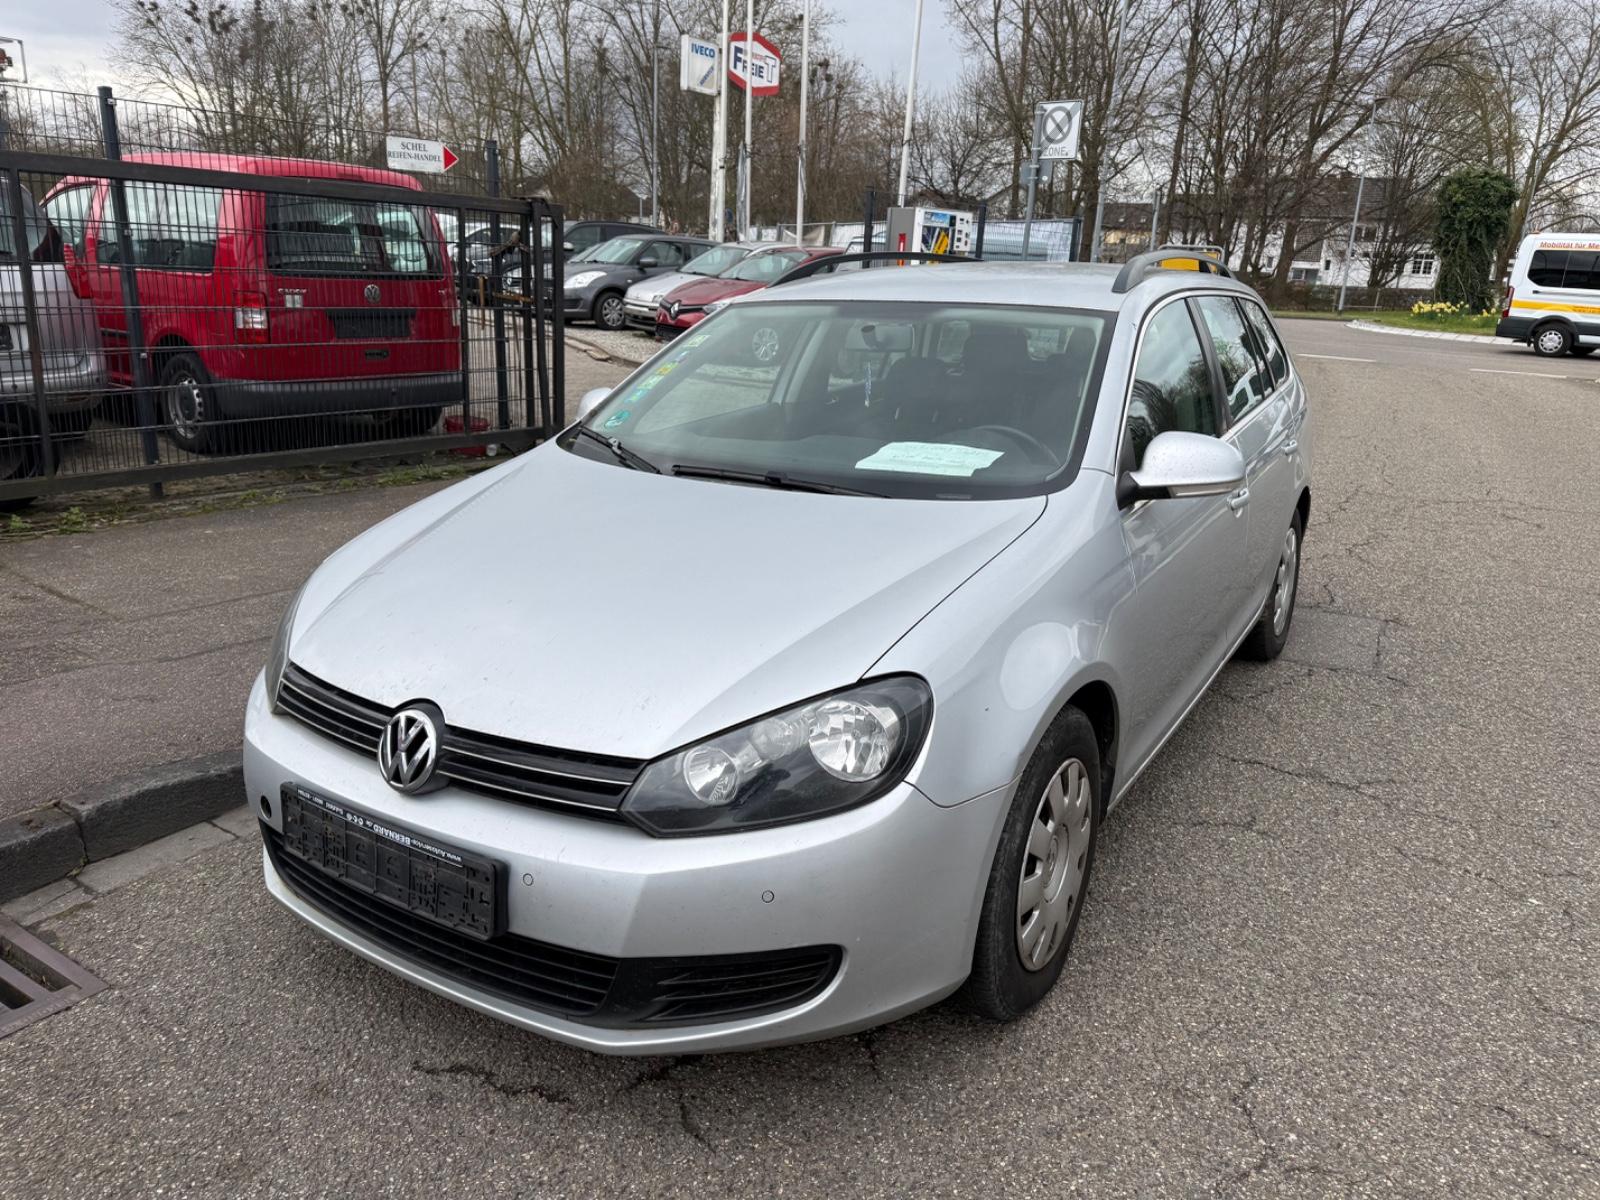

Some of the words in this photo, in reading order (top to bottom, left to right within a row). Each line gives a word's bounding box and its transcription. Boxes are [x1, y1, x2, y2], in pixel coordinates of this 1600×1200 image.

[692, 43, 716, 58] IVECO
[401, 141, 428, 152] SCHEL
[387, 150, 442, 162] REIFEN-HANDEL
[1540, 241, 1573, 249] Mobilität
